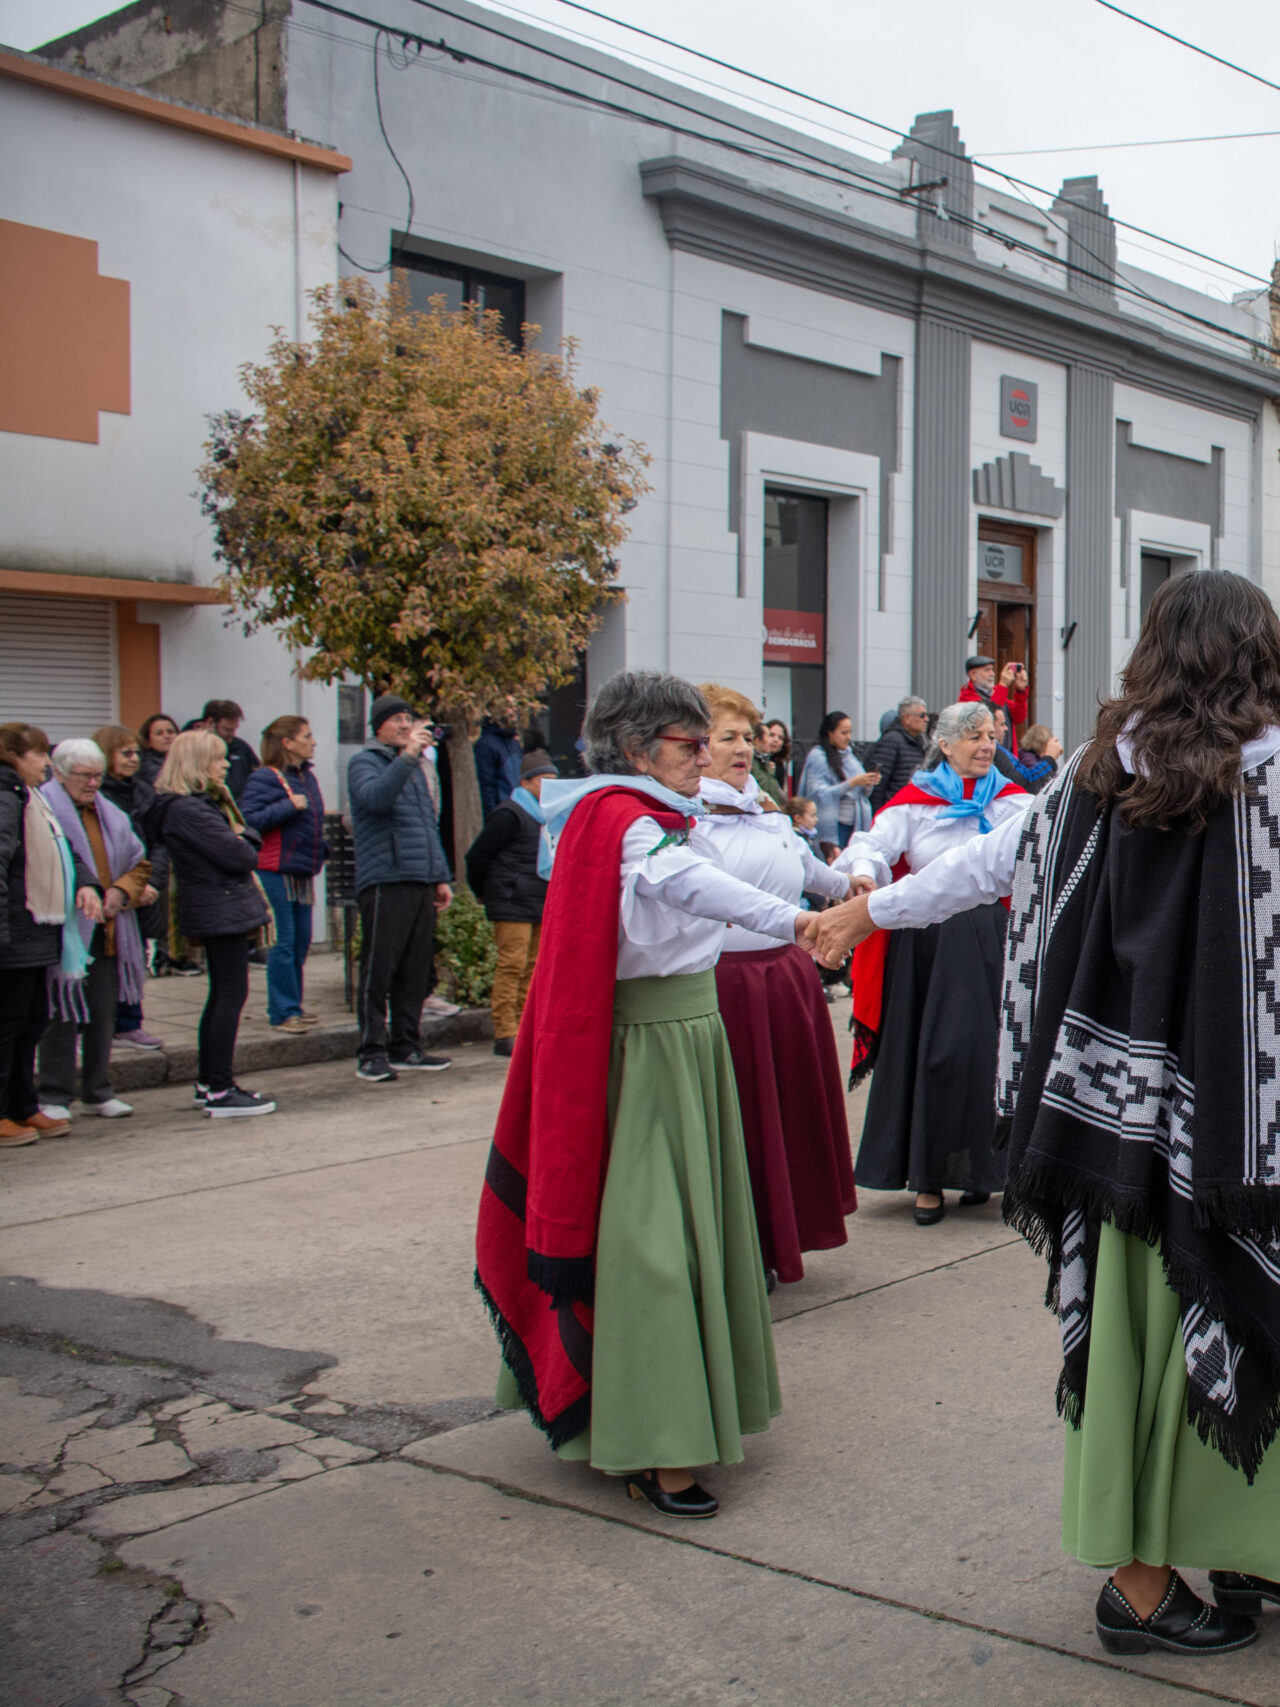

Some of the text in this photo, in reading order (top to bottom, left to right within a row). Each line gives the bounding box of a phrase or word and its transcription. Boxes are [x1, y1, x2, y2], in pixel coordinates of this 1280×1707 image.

[1009, 400, 1031, 418] UCR
[985, 556, 1005, 568] UCR
[768, 636, 816, 648] DEMOCRACIA
